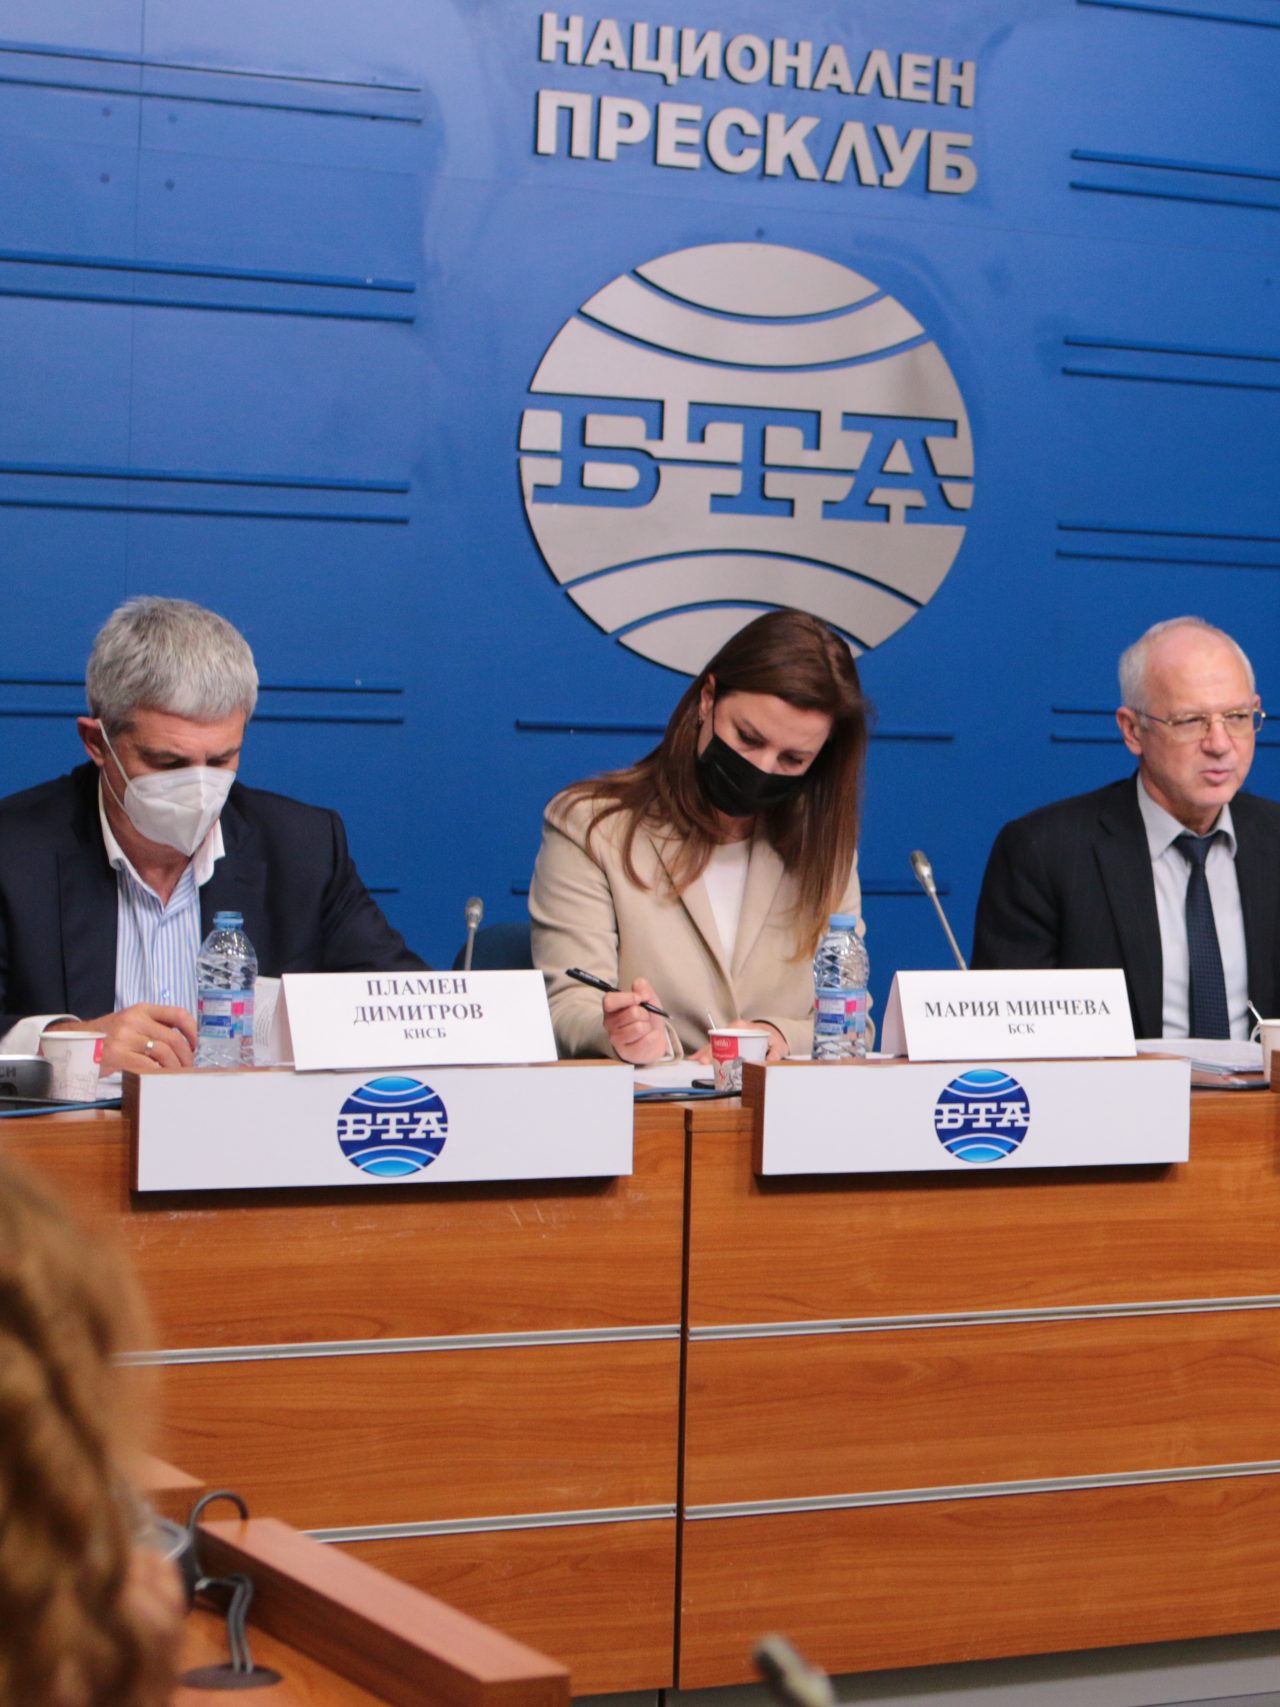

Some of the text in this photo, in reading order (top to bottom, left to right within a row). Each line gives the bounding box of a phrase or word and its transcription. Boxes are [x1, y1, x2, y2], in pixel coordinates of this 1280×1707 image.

[540, 12, 975, 106] НАЦИОНАЛЕН
[537, 89, 978, 194] ПРЕСКЛУБ
[524, 391, 970, 528] БТА
[367, 978, 468, 996] ПЛАМЕН
[353, 1003, 483, 1025] ДИМИТРОВ
[925, 1000, 1111, 1017] МАРИЯ МИНЧЕВА
[403, 1027, 447, 1040] КНСБ
[1008, 1023, 1035, 1034] БСК
[339, 1111, 448, 1141] БТА
[936, 1102, 1030, 1129] БТА
